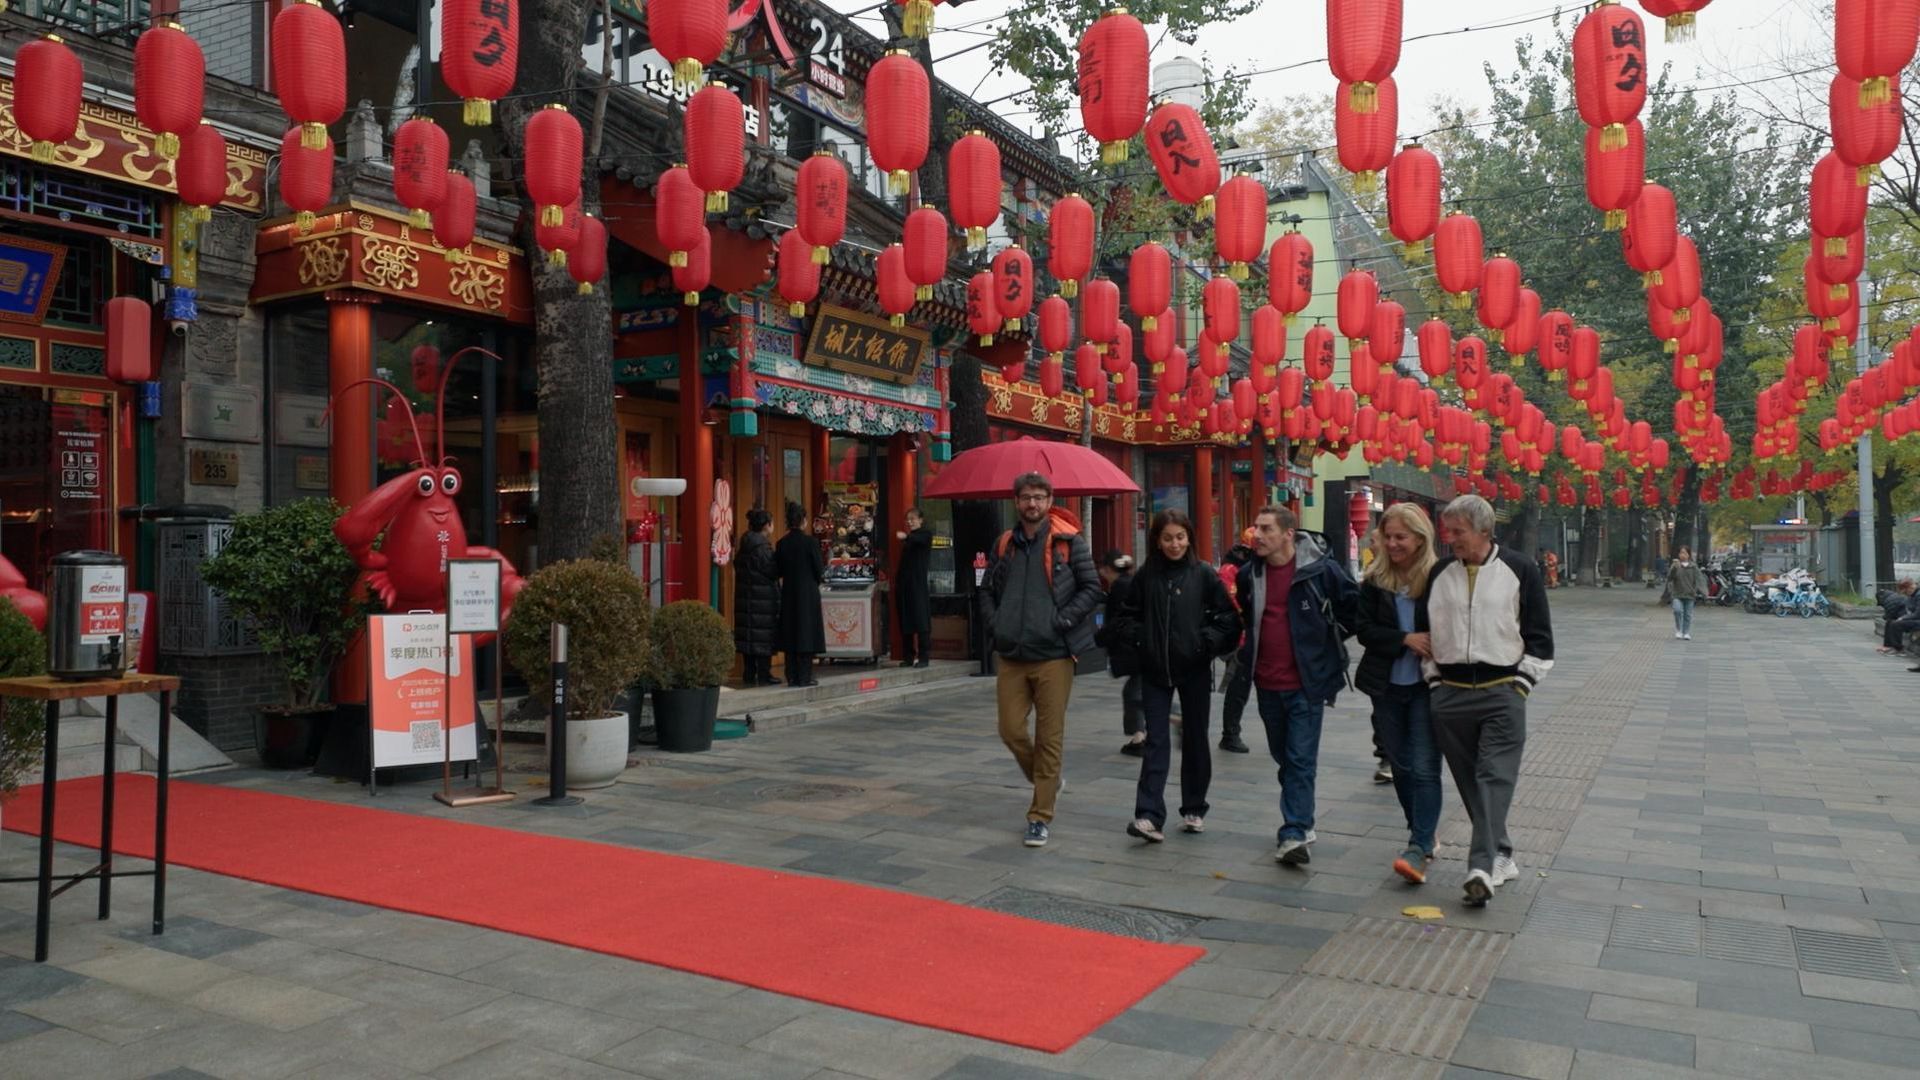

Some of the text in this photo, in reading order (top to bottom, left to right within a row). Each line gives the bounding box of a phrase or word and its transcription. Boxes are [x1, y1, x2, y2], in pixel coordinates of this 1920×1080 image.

[810, 18, 846, 76] 24
[1161, 119, 1200, 175] 日入
[1462, 346, 1477, 375] 日入
[204, 464, 227, 479] 235
